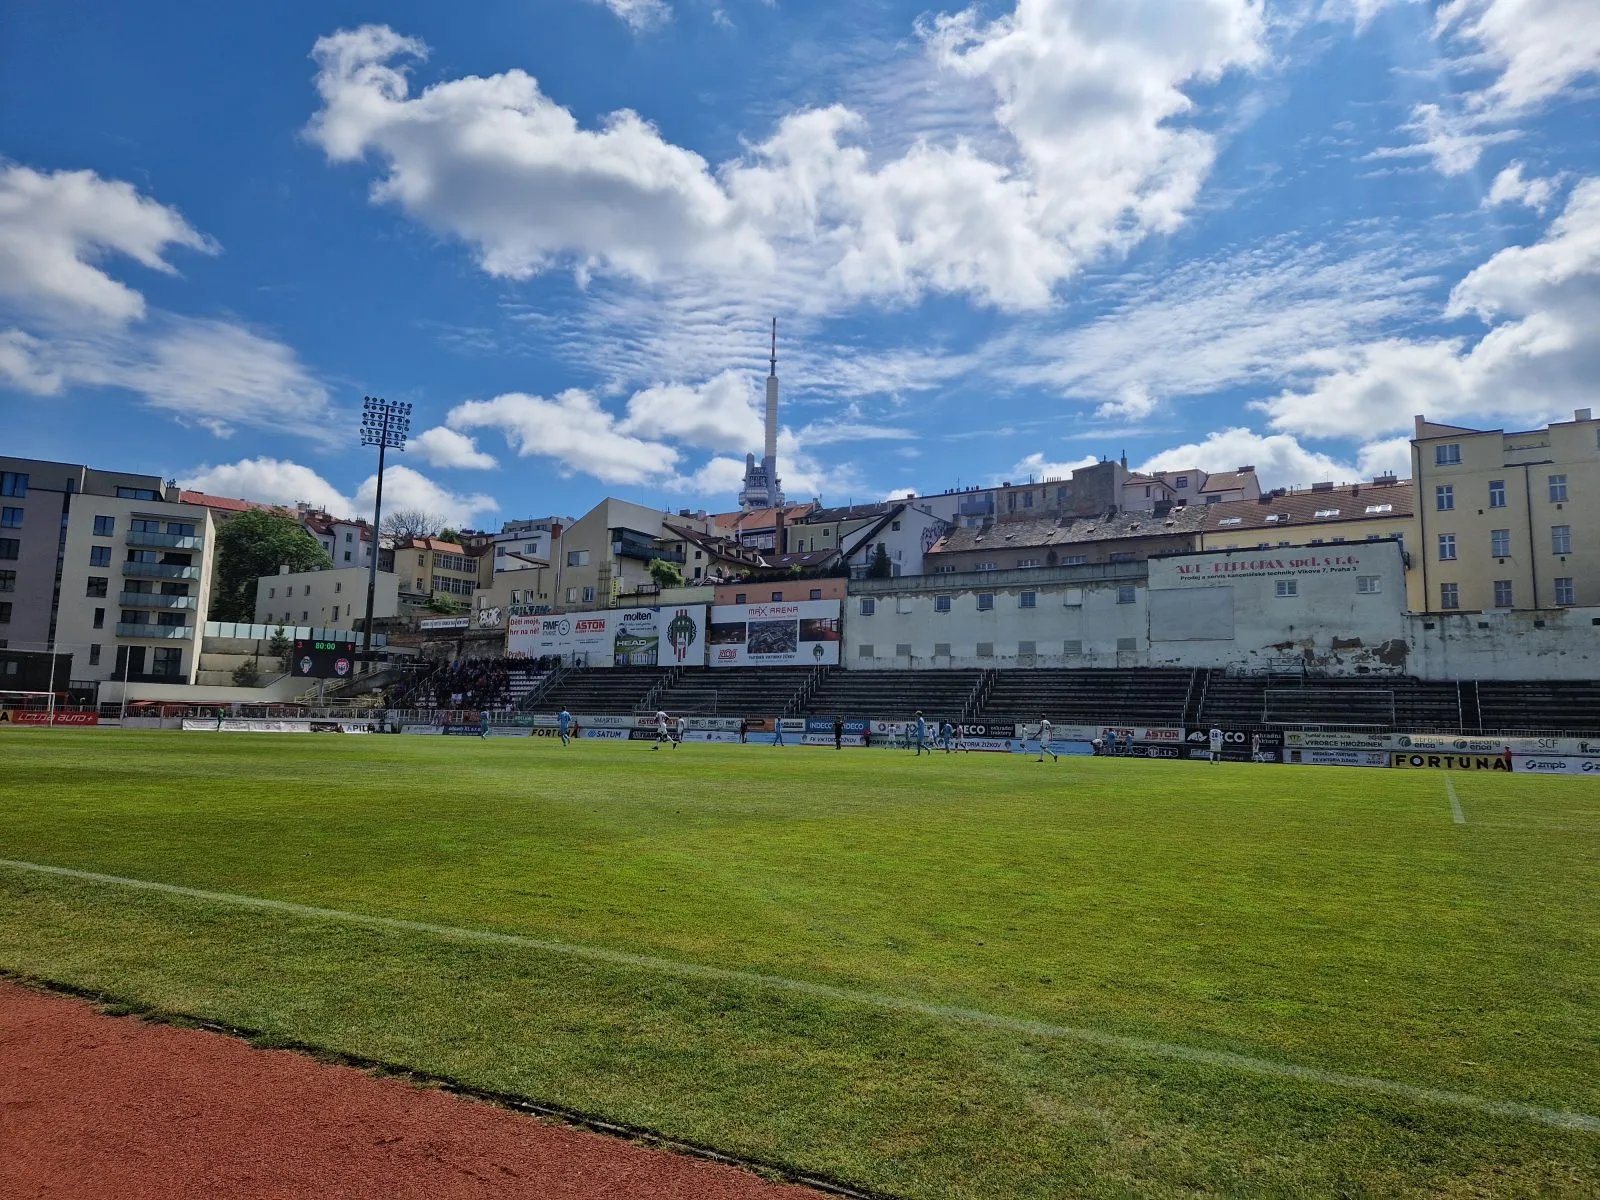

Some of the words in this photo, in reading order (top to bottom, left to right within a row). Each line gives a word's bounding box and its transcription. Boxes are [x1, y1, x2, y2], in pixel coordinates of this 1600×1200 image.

[1289, 557, 1321, 568] spol.
[1324, 557, 1331, 566] s
[748, 606, 768, 617] MAX
[770, 606, 799, 614] ARENA
[510, 617, 523, 626] Děti
[523, 617, 541, 627] moje,
[623, 612, 652, 622] molten
[575, 620, 606, 630] ASTON
[509, 627, 521, 636] hrr
[315, 642, 336, 650] 80:00
[616, 639, 647, 647] HEAD
[0, 711, 10, 722] A
[809, 722, 833, 730] INDECO
[596, 730, 622, 738] SATUM
[1102, 729, 1135, 737] ATON
[1145, 730, 1180, 738] ASTON
[1538, 738, 1558, 749] SCF
[1395, 754, 1507, 770] FORTUNA
[1536, 759, 1567, 770] zmpb
